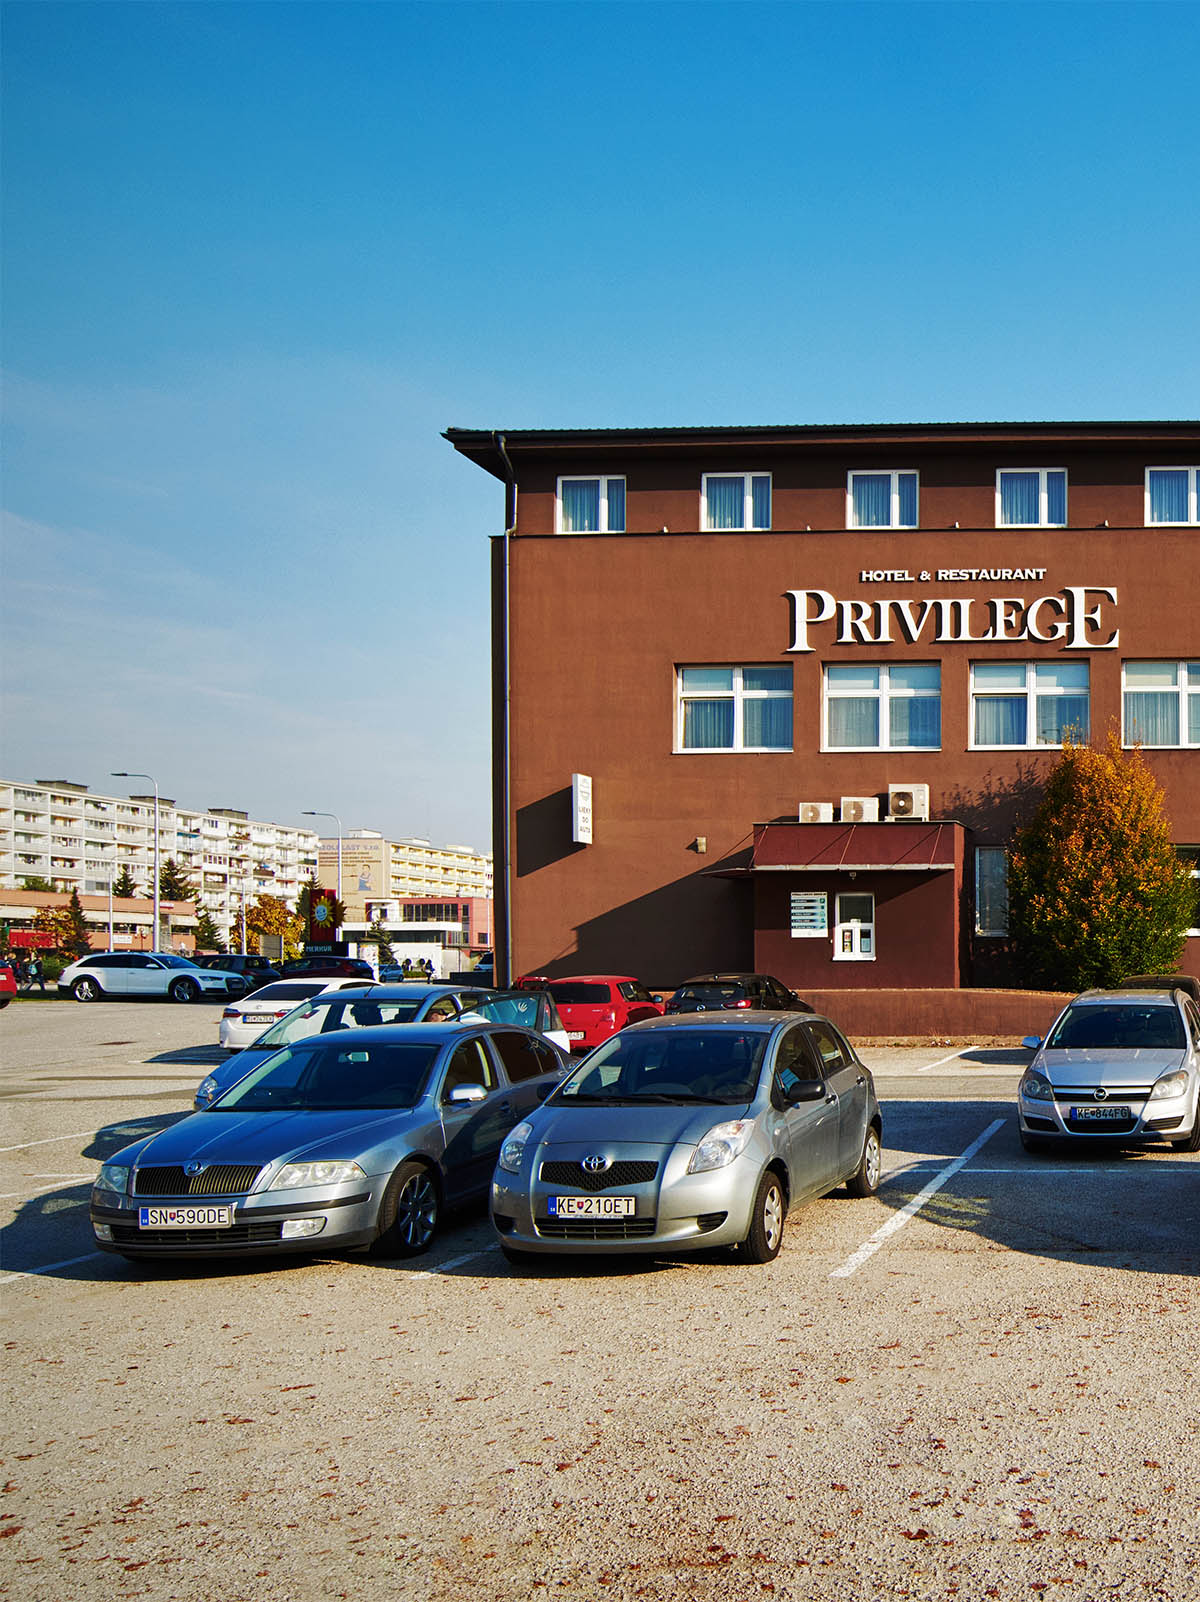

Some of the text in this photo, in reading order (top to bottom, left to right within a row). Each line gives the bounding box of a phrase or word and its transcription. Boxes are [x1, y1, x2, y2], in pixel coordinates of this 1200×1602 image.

[861, 568, 1047, 582] HOTEL & RESTAURANT
[786, 586, 1120, 653] PRIVILEGE
